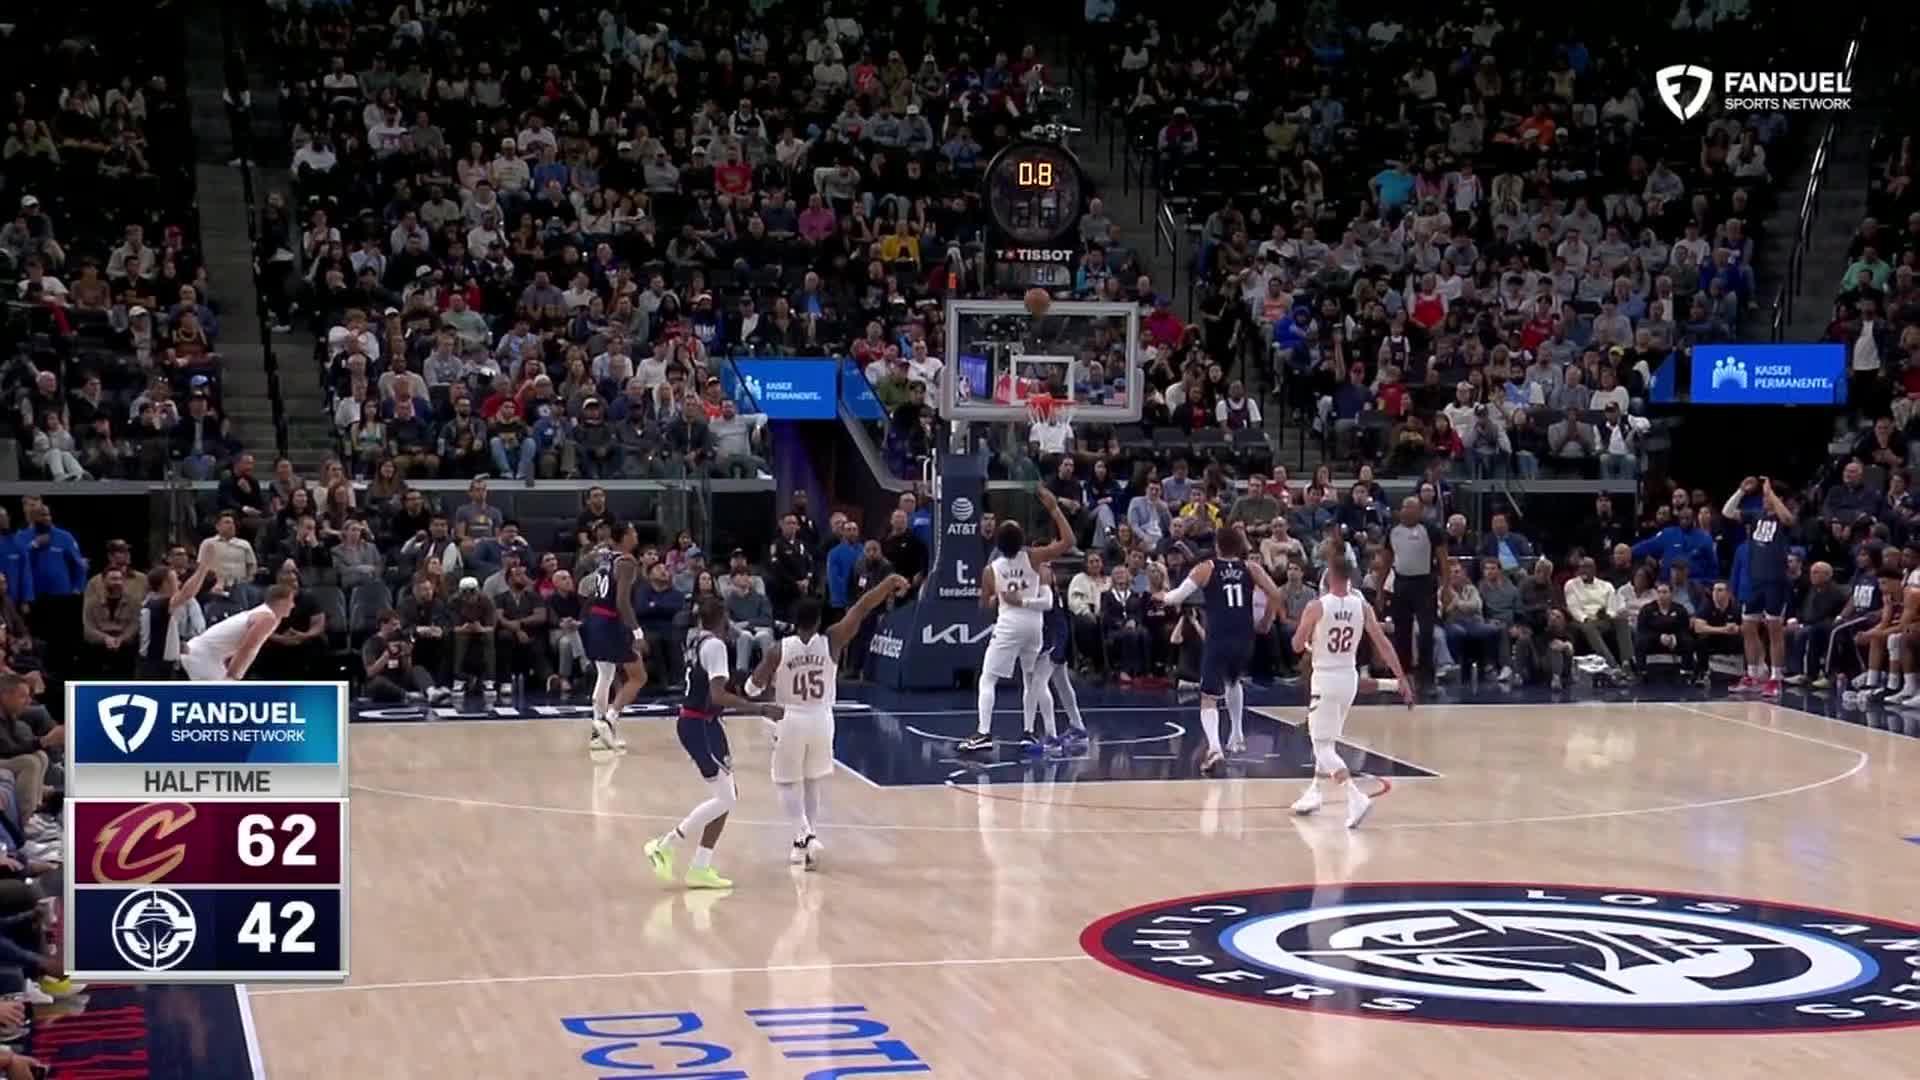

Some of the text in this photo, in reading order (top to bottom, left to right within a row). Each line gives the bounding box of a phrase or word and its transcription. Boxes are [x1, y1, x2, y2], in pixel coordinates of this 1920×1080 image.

[1019, 162, 1052, 185] 0.8
[1017, 250, 1073, 261] TISSOT
[1755, 366, 1791, 376] KAISER
[947, 524, 977, 535] AT&T
[1223, 584, 1243, 607] 11
[1327, 626, 1354, 653] 32
[793, 670, 825, 701] 45
[1527, 889, 1741, 914] LOS
[1133, 904, 1424, 1012] CLIPPERS
